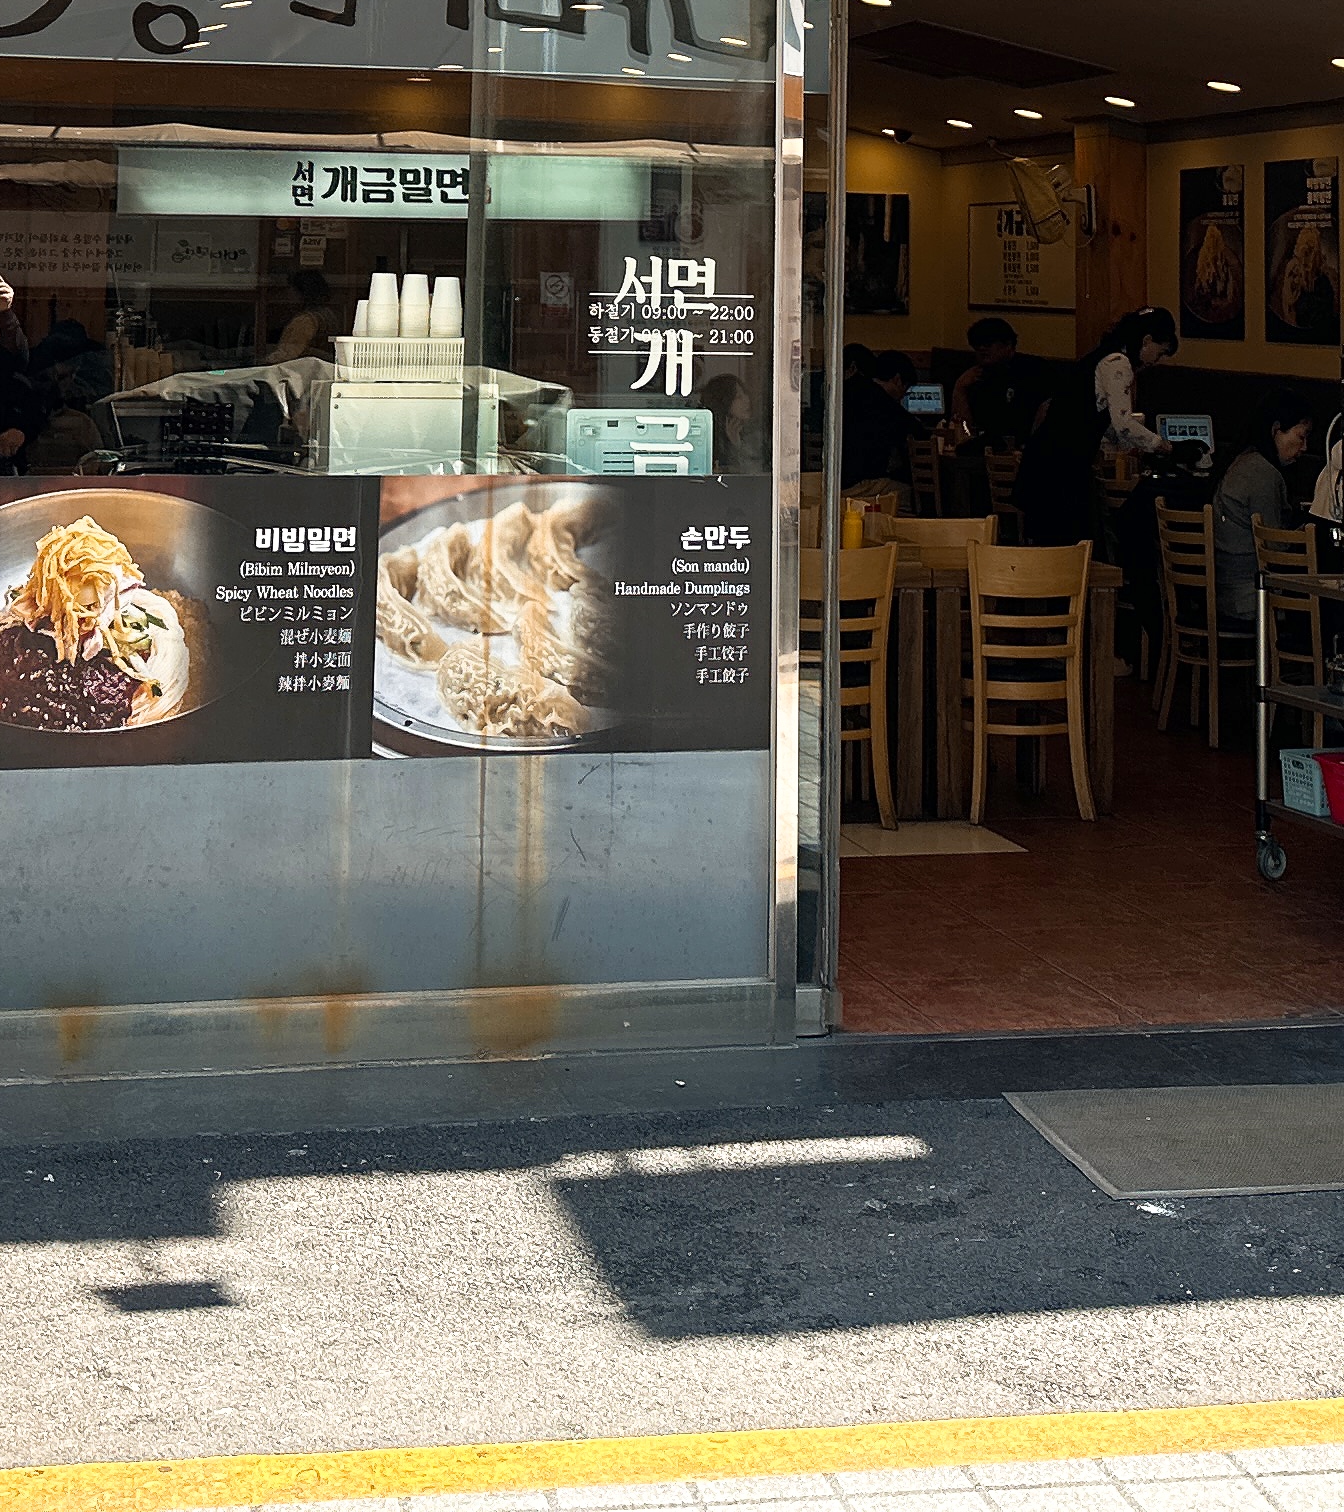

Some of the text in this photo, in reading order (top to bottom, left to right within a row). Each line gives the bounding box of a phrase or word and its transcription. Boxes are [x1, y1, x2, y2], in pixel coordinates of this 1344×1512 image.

[292, 160, 469, 208] 서면 개금밀면
[613, 255, 716, 311] 서면
[588, 302, 635, 320] 하절기
[641, 306, 687, 321] 09:00
[709, 306, 754, 321] 22:00
[587, 326, 635, 344] 동절기
[709, 329, 754, 345] 21:00
[630, 329, 694, 397] 개
[630, 415, 694, 475] 금
[255, 527, 357, 553] 비빔밀면
[680, 526, 751, 551] 손만두
[239, 560, 355, 578] (Bibim Milmyeon)
[671, 557, 750, 574] (Son mandu)
[215, 584, 354, 602] Spicy Wheat Noodles
[614, 581, 751, 597] Handmade Dumplings
